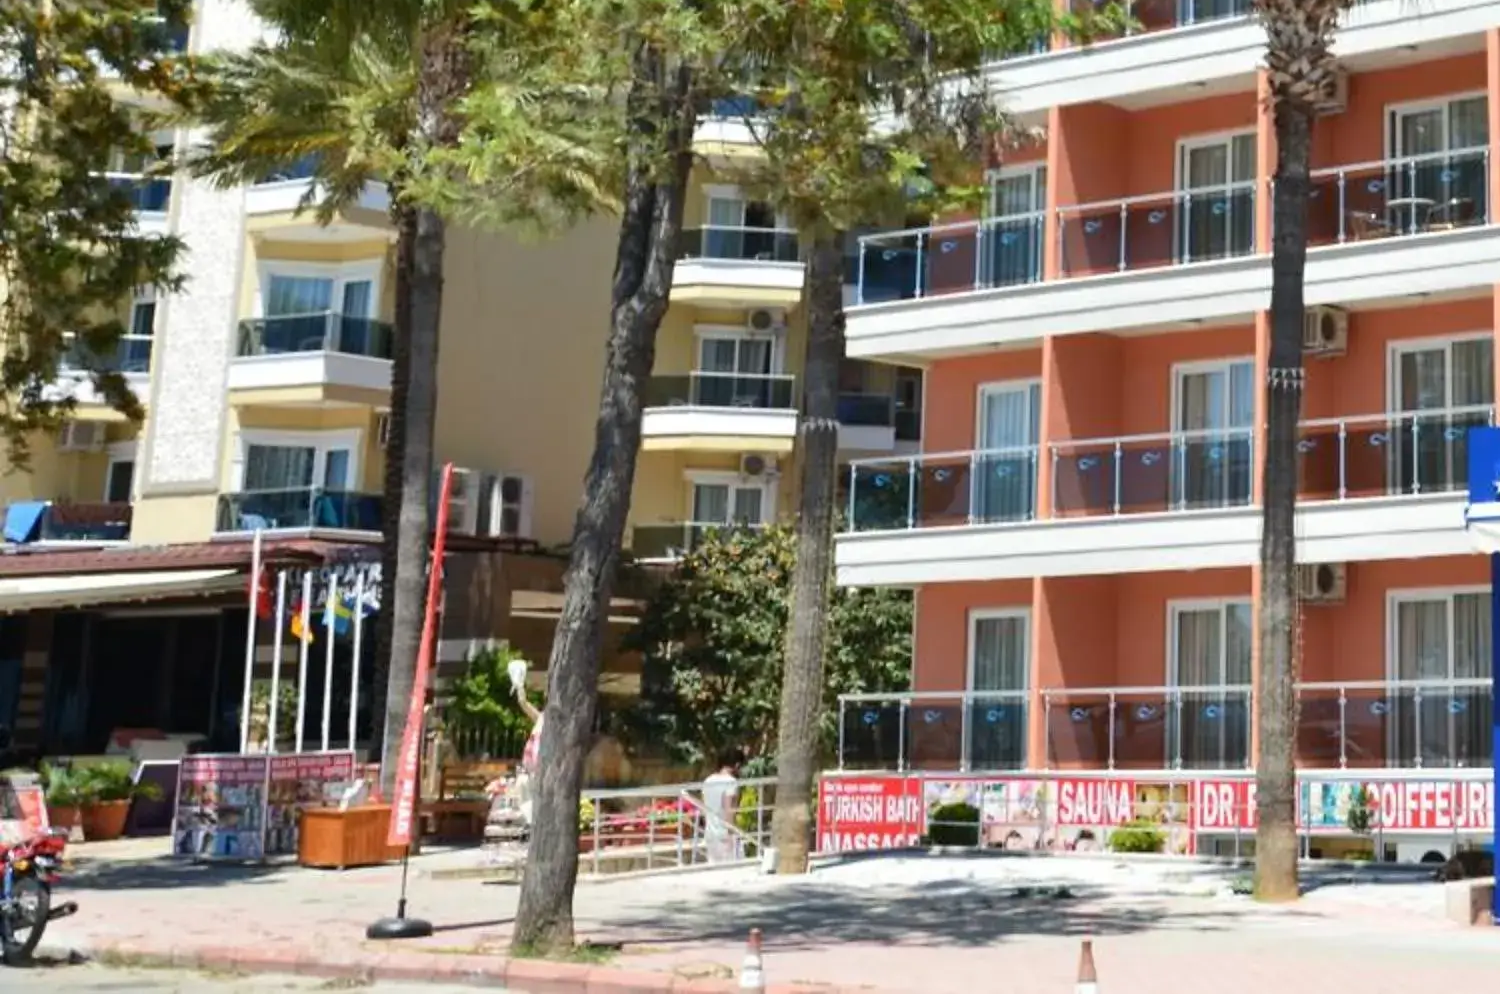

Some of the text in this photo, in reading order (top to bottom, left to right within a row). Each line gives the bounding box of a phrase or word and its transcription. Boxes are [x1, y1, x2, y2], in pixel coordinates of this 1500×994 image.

[824, 794, 884, 823] TURKISH
[1060, 781, 1131, 824] SAUNA
[1366, 781, 1486, 827] COIFFEUR
